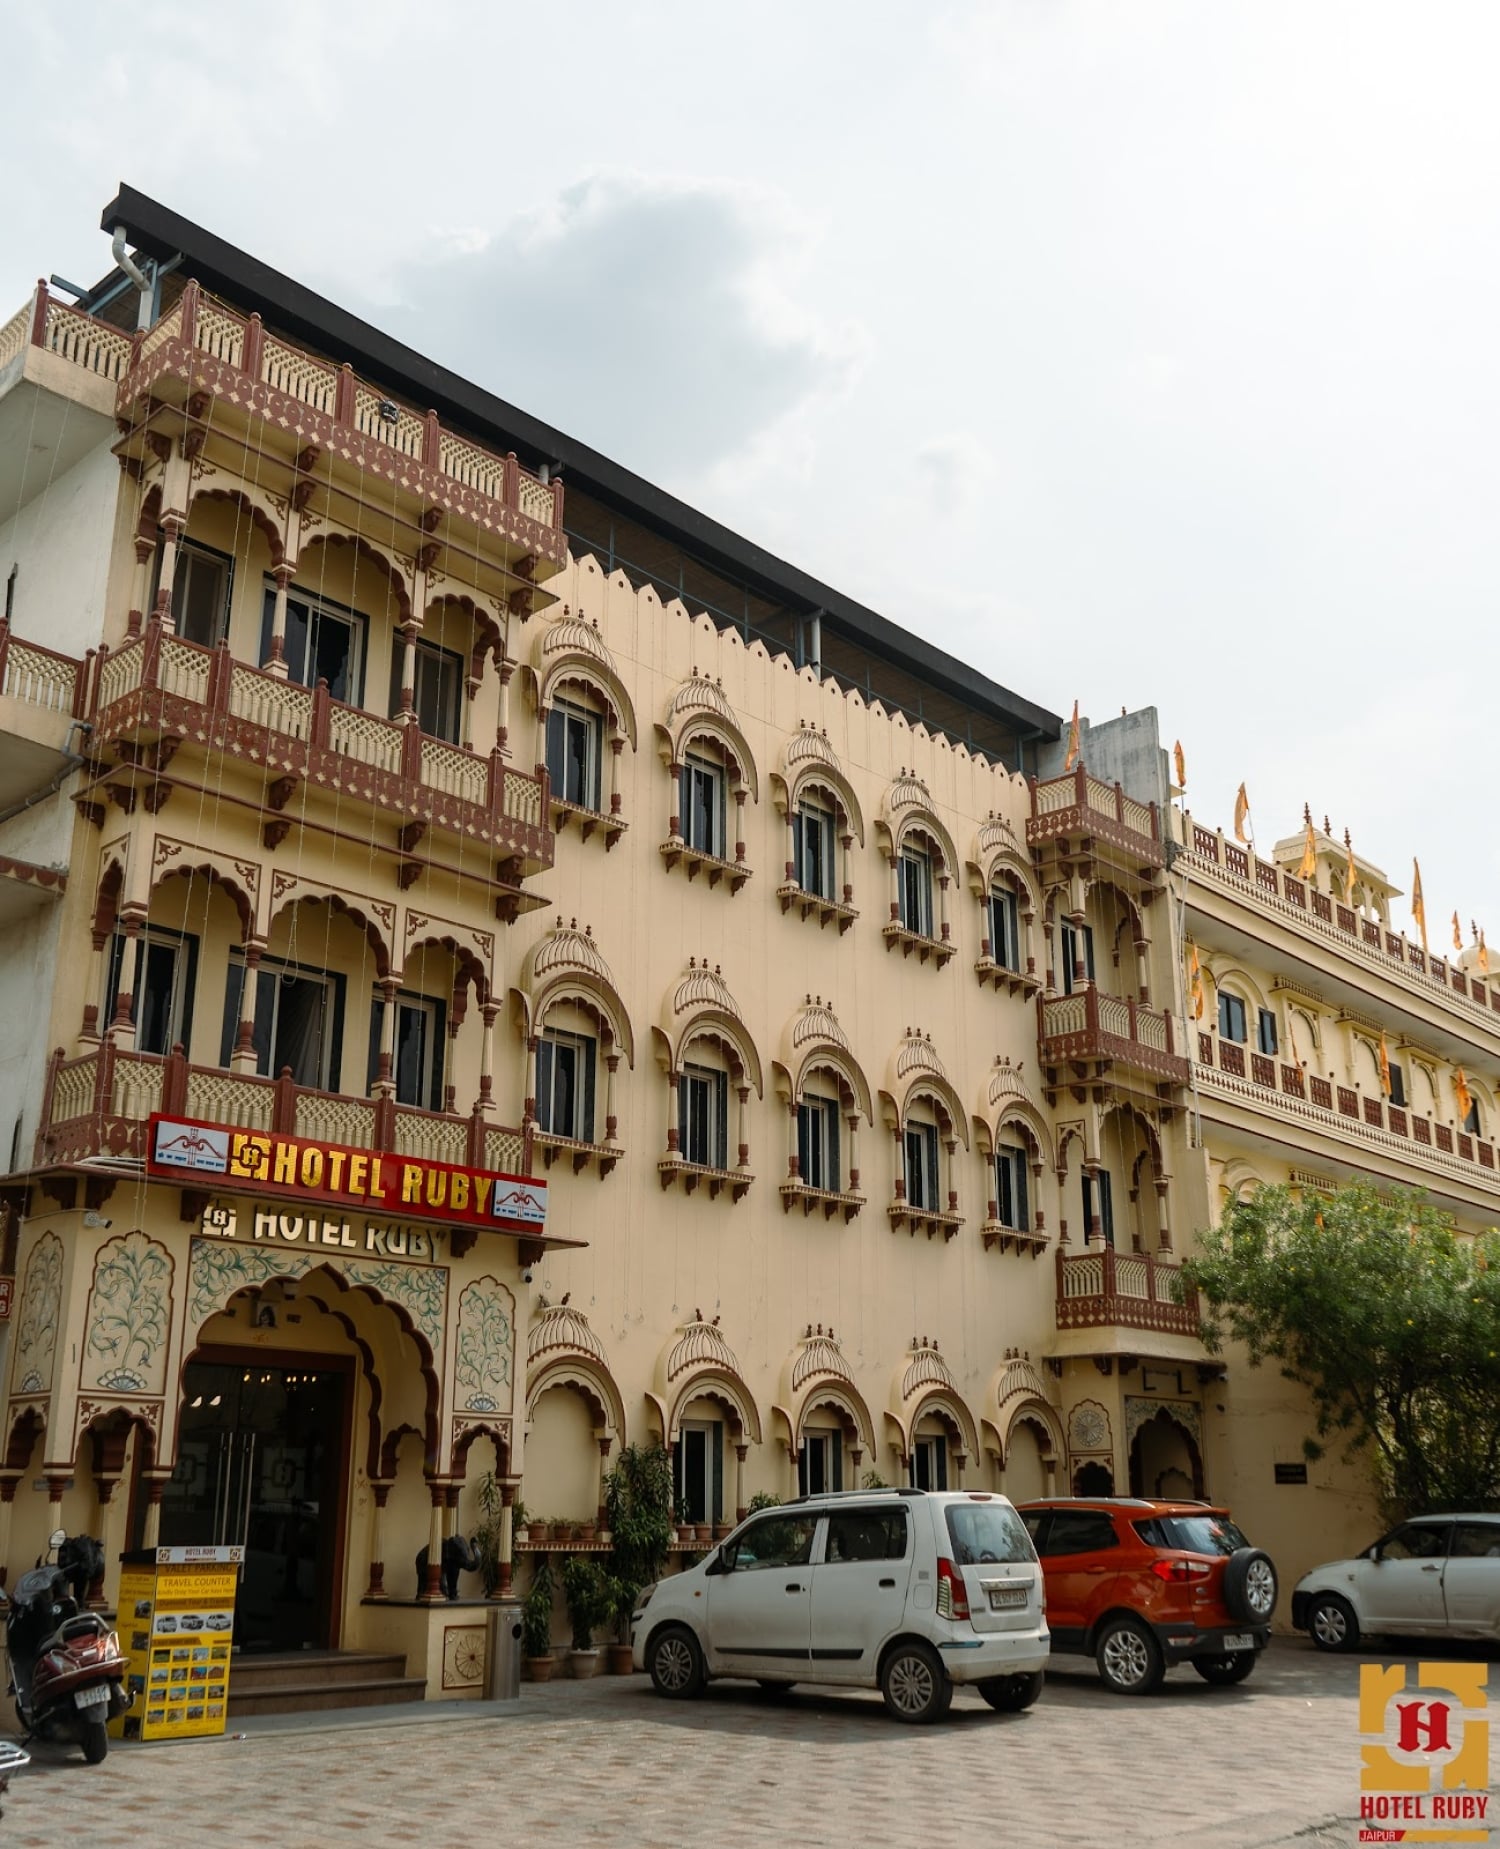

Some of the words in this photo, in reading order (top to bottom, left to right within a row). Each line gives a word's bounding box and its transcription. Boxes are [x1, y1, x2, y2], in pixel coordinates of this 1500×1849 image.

[273, 1141, 386, 1198] HOTEL
[401, 1164, 492, 1214] RUBY
[254, 1206, 357, 1248] HOTEL
[365, 1218, 447, 1263] RUBY
[185, 1548, 201, 1556] HOTEL
[164, 1563, 192, 1574] VALET
[195, 1562, 233, 1573] PARKING
[164, 1578, 192, 1588] TRAVEL
[194, 1576, 231, 1586] COUNTER
